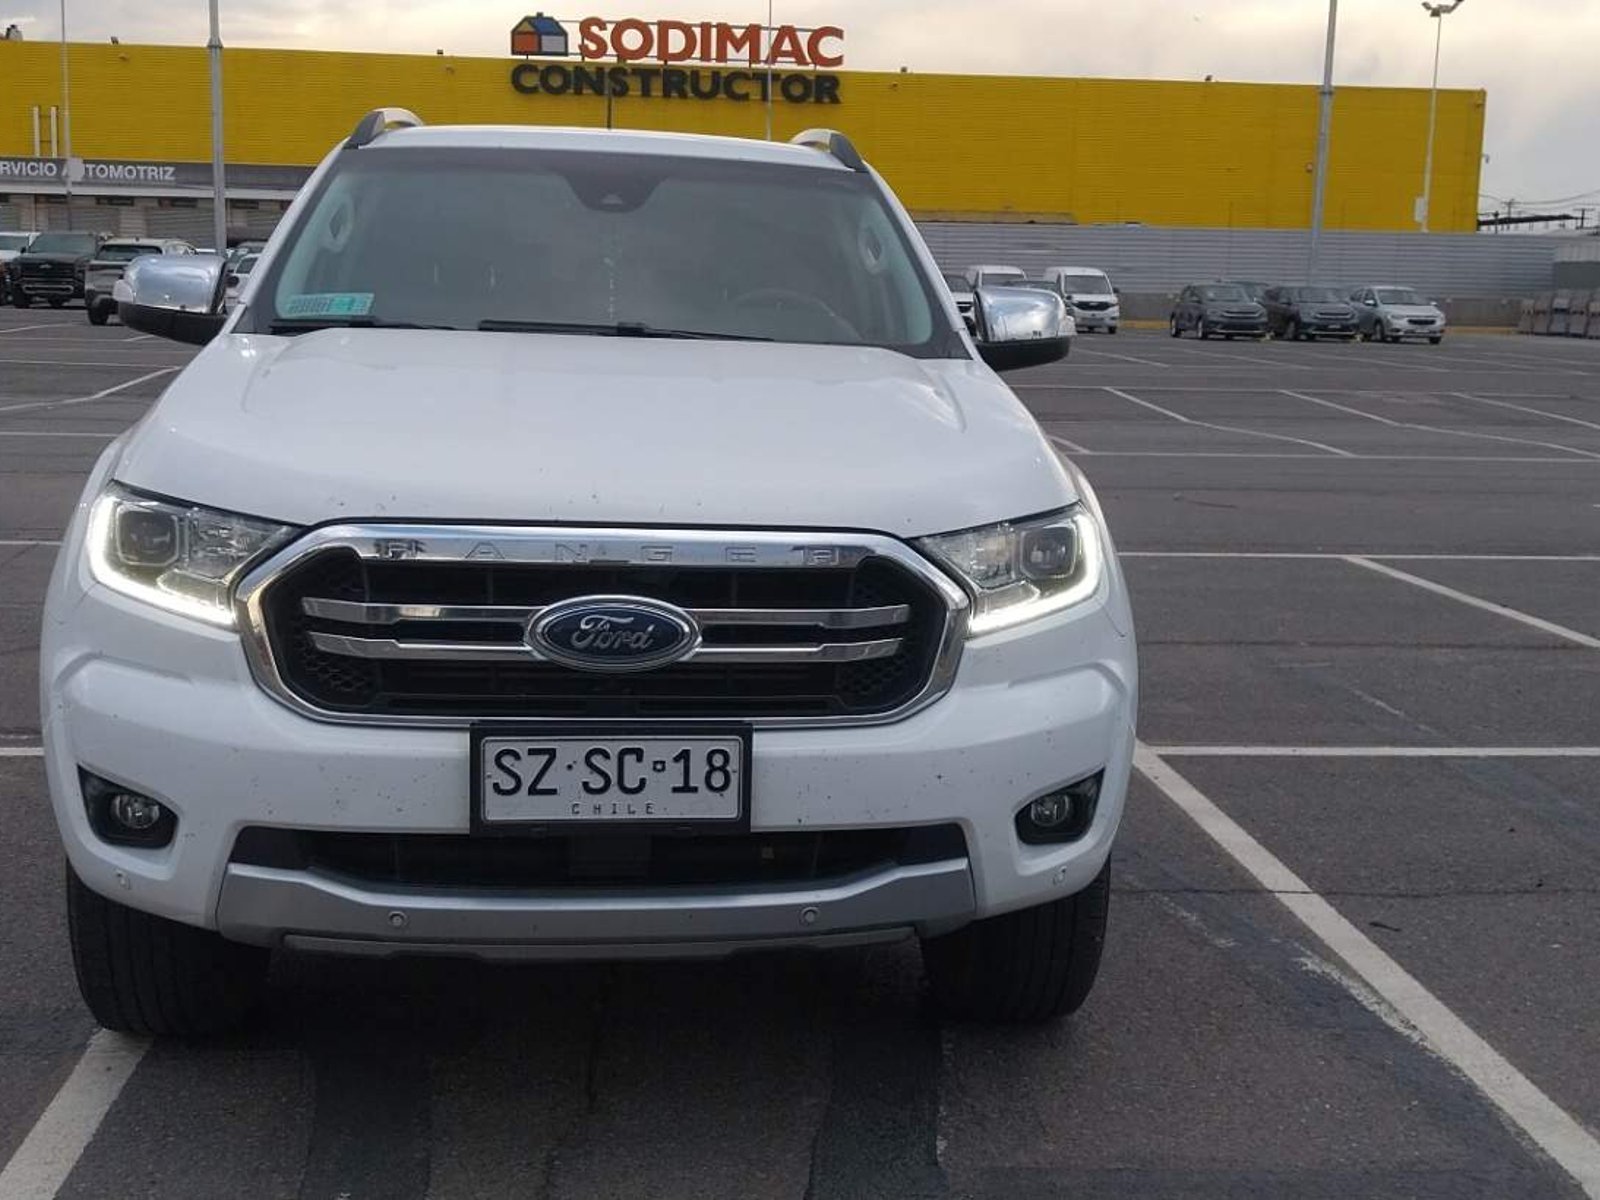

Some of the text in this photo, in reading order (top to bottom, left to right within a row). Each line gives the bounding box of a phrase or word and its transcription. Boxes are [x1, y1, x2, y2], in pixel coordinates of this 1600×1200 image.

[578, 17, 844, 67] SODIMAC
[511, 64, 842, 104] CONSTRUCTOR
[61, 163, 176, 180] TOMOTRIZ
[388, 541, 840, 566] RANGER
[570, 614, 655, 649] Ford
[571, 802, 655, 815] CHILE
